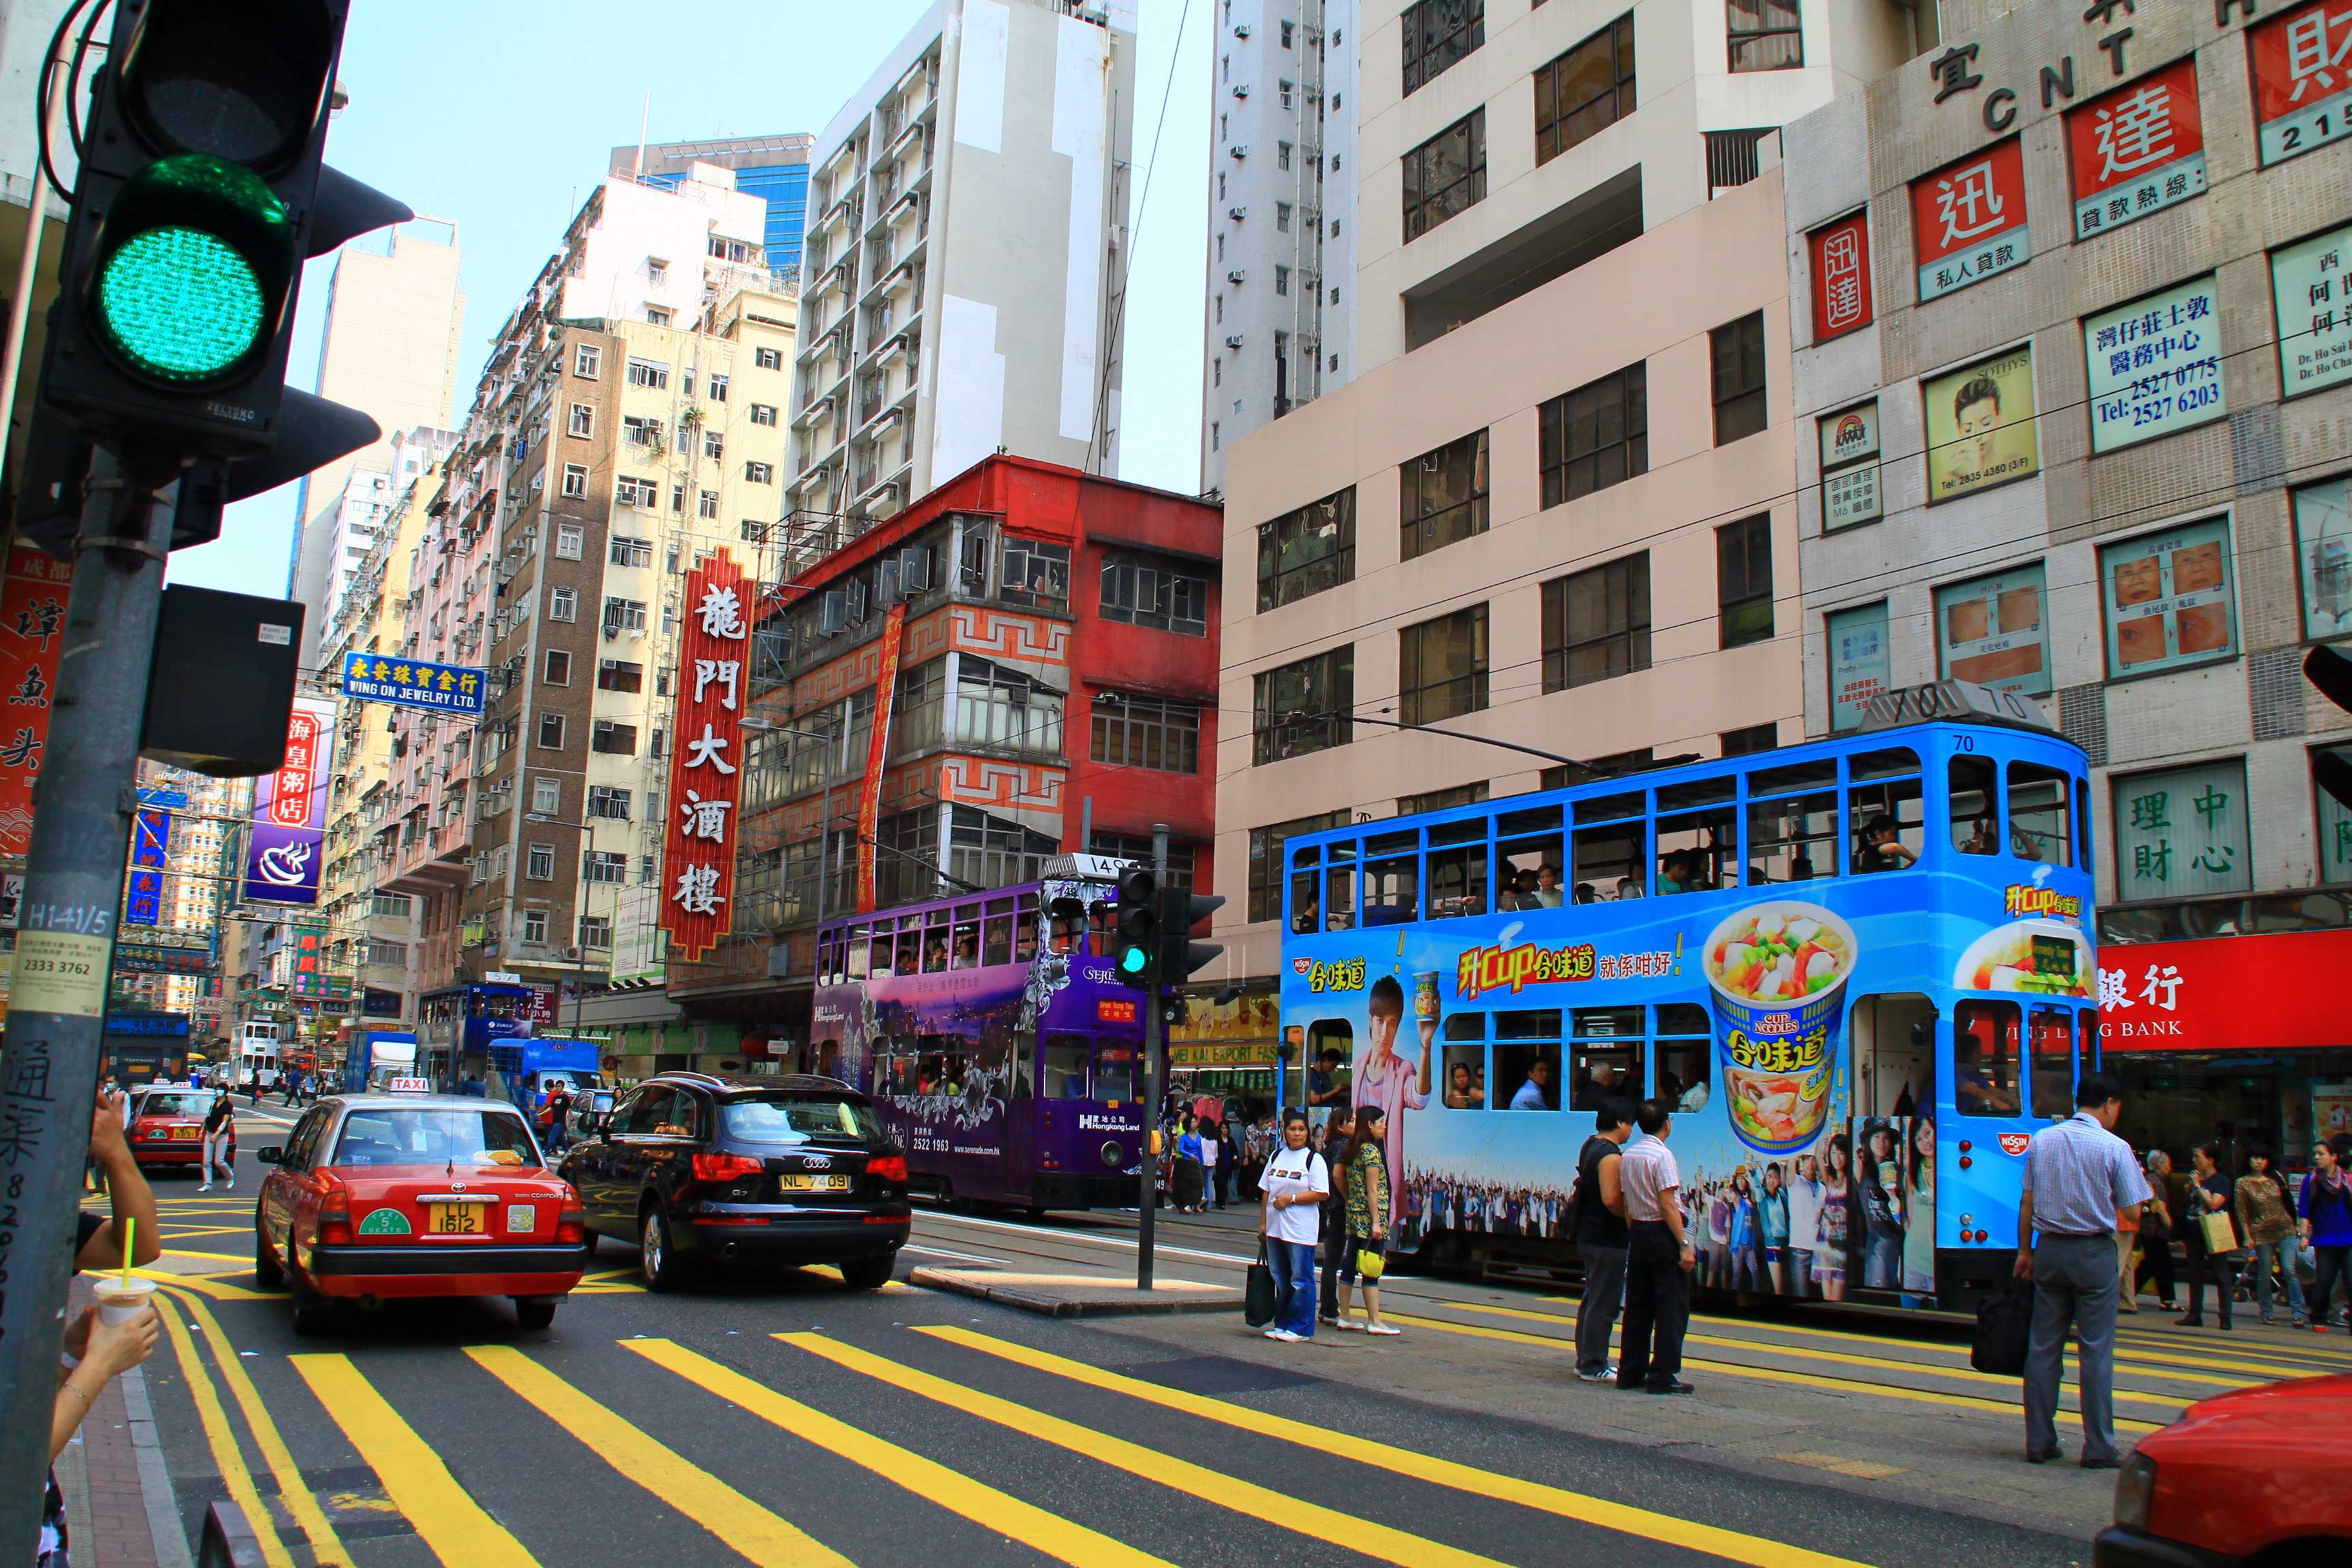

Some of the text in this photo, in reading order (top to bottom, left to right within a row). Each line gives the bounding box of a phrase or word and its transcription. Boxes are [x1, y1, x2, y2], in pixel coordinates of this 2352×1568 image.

[1936, 244, 2014, 289] 私人貸款
[2096, 294, 2209, 353] 灣仔莊士敦
[2110, 329, 2200, 376] 醫務中心
[2298, 342, 2347, 365] Dr. Ho Sai
[1976, 355, 2028, 380] SOTHYS
[2300, 353, 2352, 380] Dr. Ho Cha
[2132, 355, 2217, 402] 2527 0775
[2098, 397, 2129, 424] Tel:
[2134, 382, 2219, 427] 2527 6203
[1941, 479, 1957, 491] Tel:
[1959, 471, 1981, 486] 2835
[1984, 464, 2006, 480] 4380
[350, 657, 478, 694] 永安珠寶金行
[350, 681, 476, 708] WING ON JEWELRY LTD.
[1895, 683, 1938, 723] 70
[1979, 686, 2027, 719] 70
[673, 583, 746, 916] 龍門大酒樓
[1953, 734, 1974, 751] 70
[280, 719, 312, 819] 海皇粥店
[24, 960, 90, 975] 2333 3762
[1294, 960, 1310, 968] NISSIN
[1307, 955, 1366, 993] 合味道
[1113, 1002, 1124, 1010] Tong
[1753, 1020, 1799, 1034] NOODLES
[1763, 1013, 1791, 1024] CUP
[2122, 1021, 2184, 1036] BANK
[547, 1039, 574, 1051] Mobil
[1213, 1045, 1252, 1062] EXPORT
[1727, 1024, 1827, 1073] 合味道
[395, 1079, 426, 1089] TAXI
[913, 1137, 930, 1150] 2522
[932, 1139, 949, 1152] 1963
[954, 1145, 1000, 1156] www.serenade.com.hk
[2002, 1135, 2027, 1148] NISSIN
[785, 1175, 846, 1187] NL 7409
[381, 1217, 389, 1226] 5
[446, 1203, 468, 1218] LU
[440, 1218, 474, 1232] 1612
